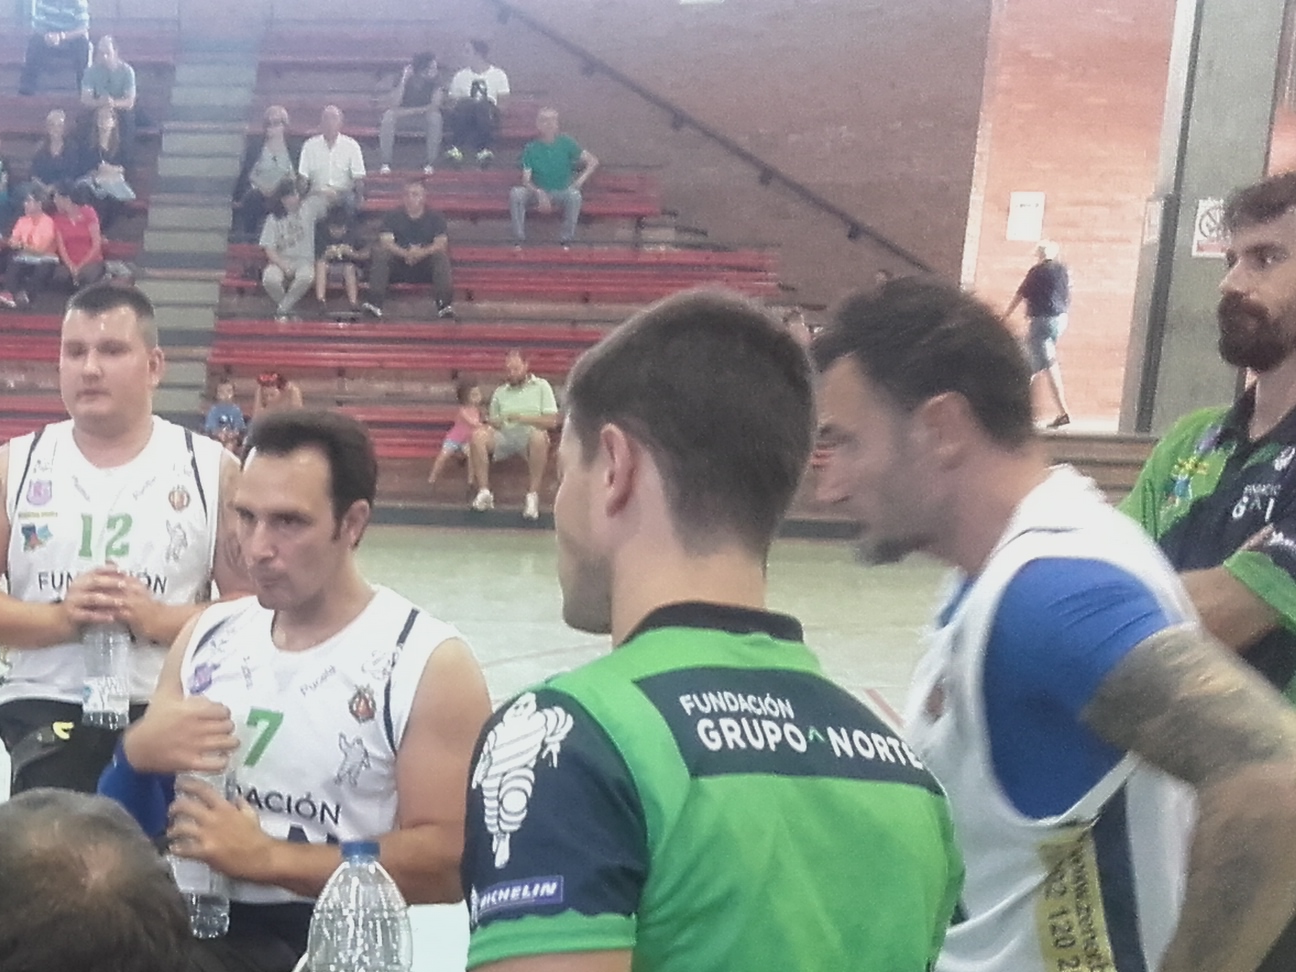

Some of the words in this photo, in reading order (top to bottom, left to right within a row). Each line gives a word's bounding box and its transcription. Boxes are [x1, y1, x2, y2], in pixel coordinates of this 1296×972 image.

[78, 513, 133, 558] 12
[38, 566, 167, 595] FUNÓN
[679, 690, 796, 719] FUNDACIÓN
[244, 706, 284, 768] 7
[697, 717, 808, 754] GRUPO
[826, 726, 924, 771] NORTE
[226, 774, 342, 826] ACIÓN
